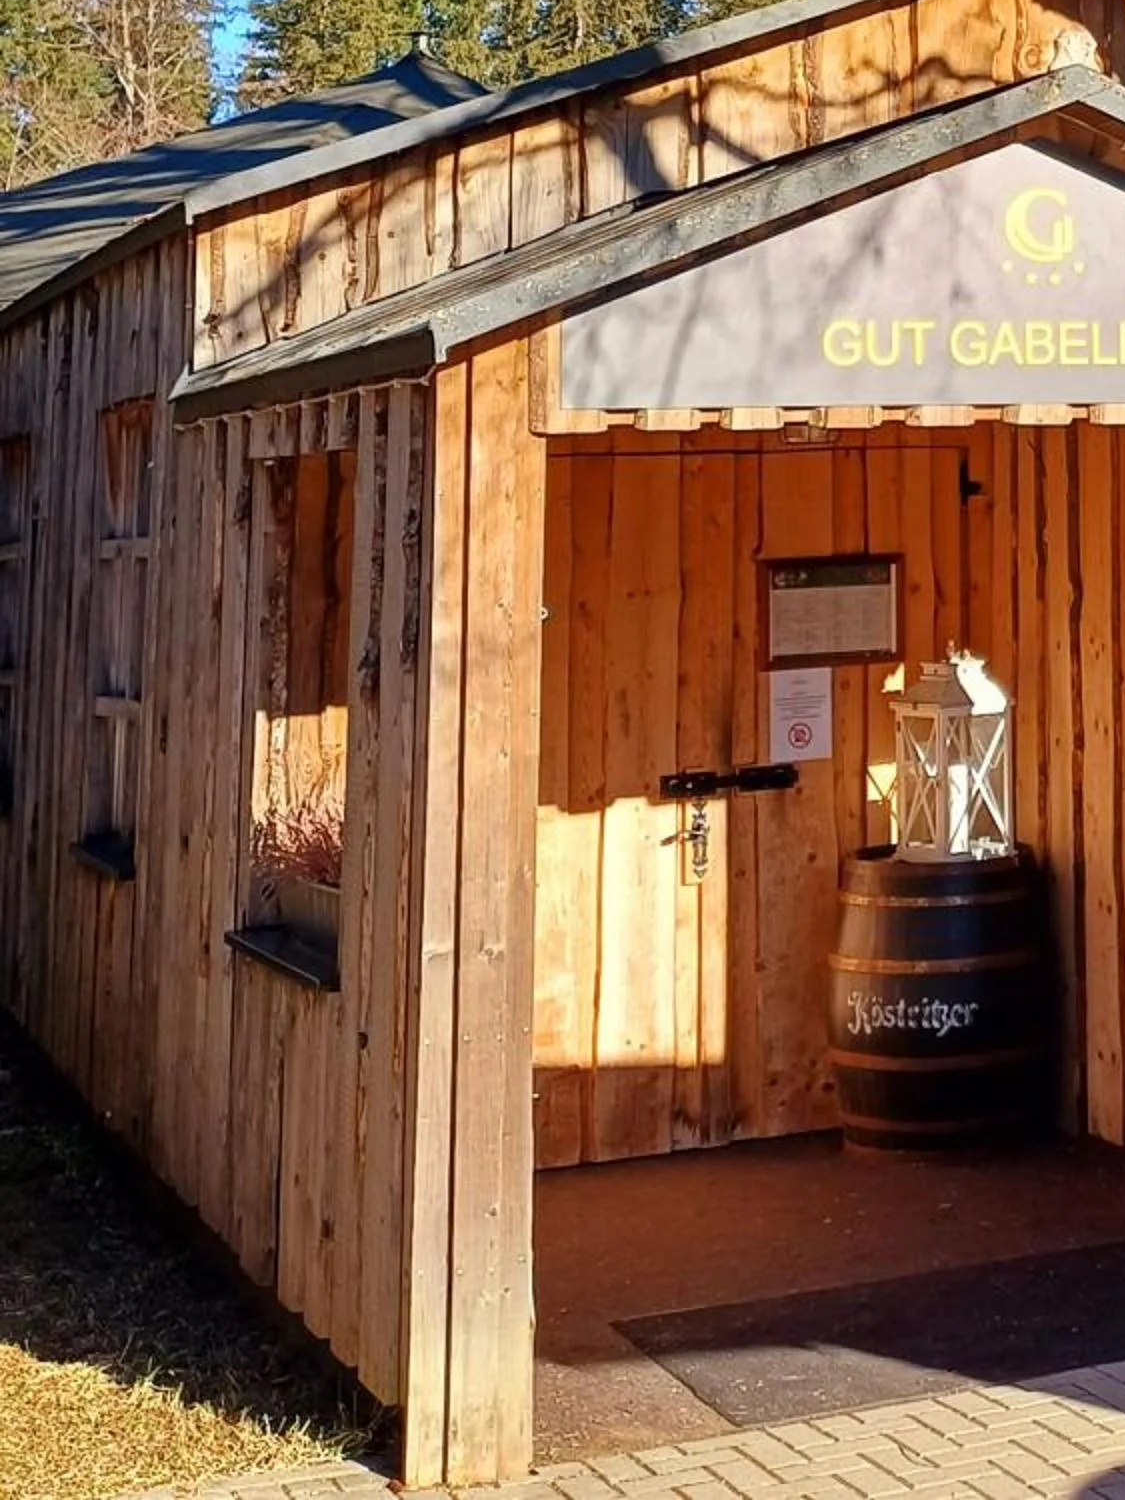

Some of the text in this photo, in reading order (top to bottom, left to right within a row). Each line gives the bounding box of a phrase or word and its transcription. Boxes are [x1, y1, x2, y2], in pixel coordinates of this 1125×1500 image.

[1004, 188, 1074, 262] G
[823, 320, 935, 366] GUT
[847, 991, 979, 1037] Köstritzer
